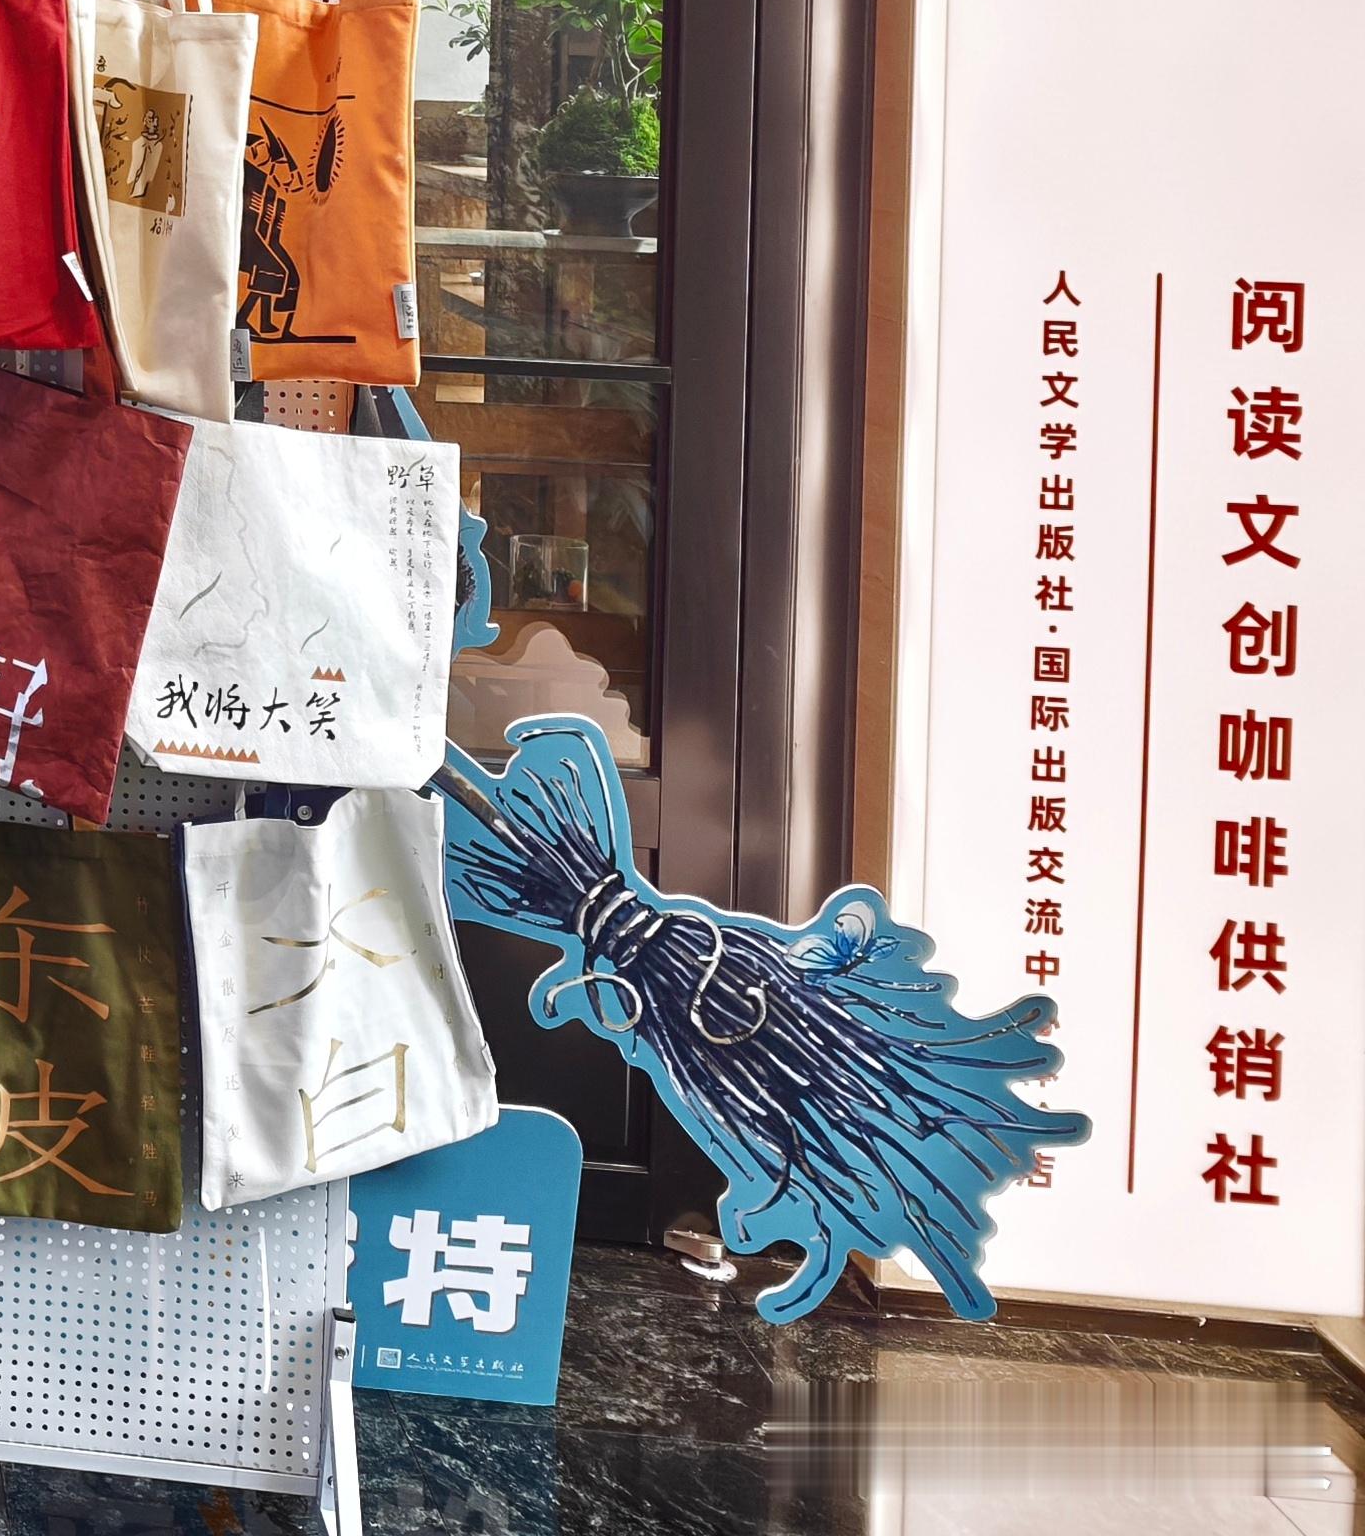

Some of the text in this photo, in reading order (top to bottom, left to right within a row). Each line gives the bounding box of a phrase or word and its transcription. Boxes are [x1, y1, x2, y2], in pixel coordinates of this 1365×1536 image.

[388, 464, 434, 492] 野草
[156, 674, 342, 740] 我将大笑
[1201, 277, 1305, 1206] 阅读文创咖啡供销社
[347, 1209, 533, 1333] 特
